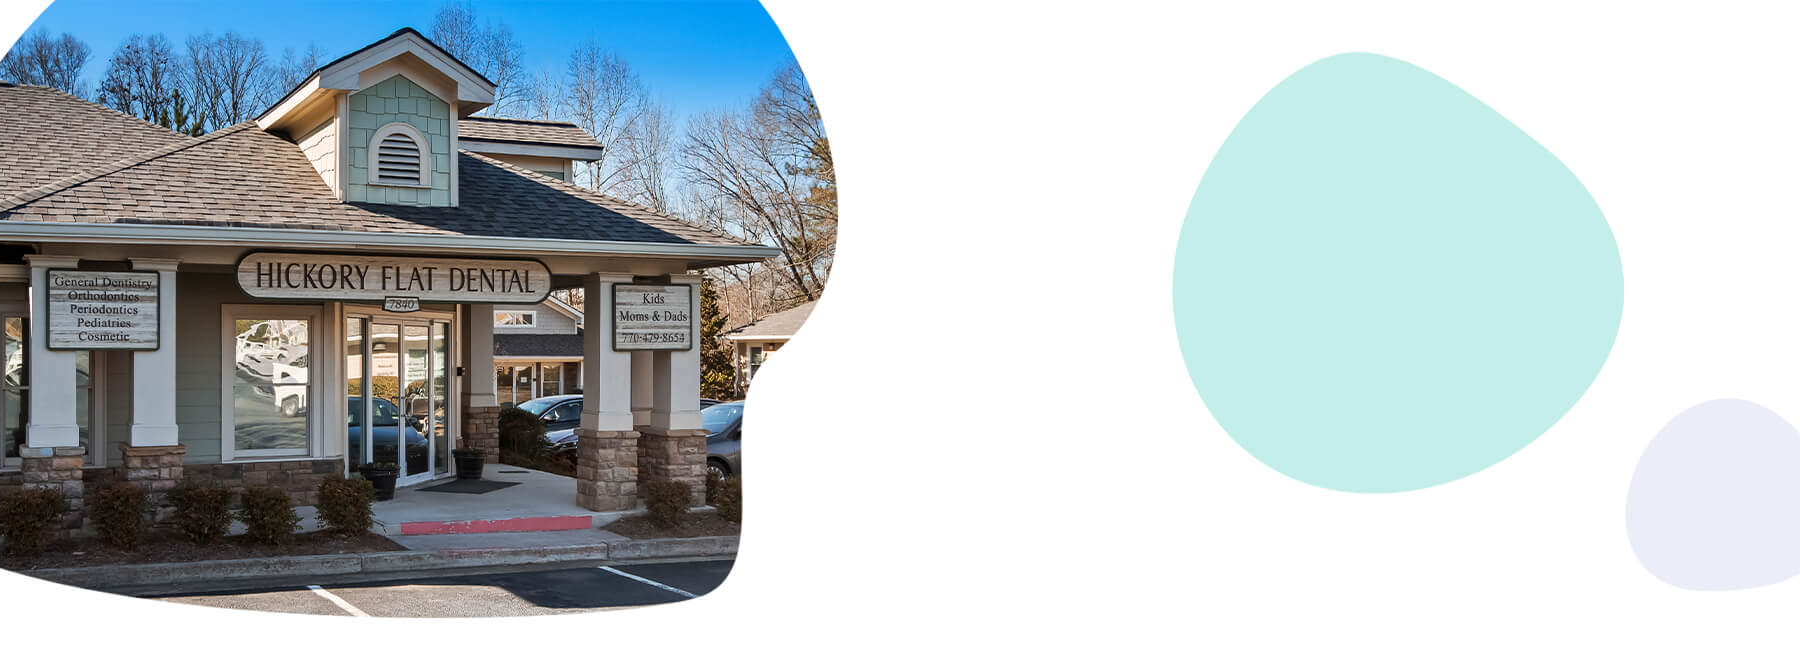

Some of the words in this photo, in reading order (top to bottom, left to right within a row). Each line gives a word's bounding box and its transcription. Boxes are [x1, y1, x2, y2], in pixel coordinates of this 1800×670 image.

[54, 276, 98, 287] General
[103, 277, 152, 289] Dentistry
[256, 262, 369, 290] HICKORY
[381, 265, 437, 292] FLAT
[450, 267, 536, 294] DENTAL
[68, 290, 140, 301] Orthodontics
[643, 293, 665, 304] Kids
[70, 304, 138, 314] Periodontics
[388, 300, 415, 310] 7840
[620, 310, 649, 321] Moms
[652, 310, 660, 321] &
[664, 310, 688, 321] Dads
[78, 331, 130, 342] Cosmetic
